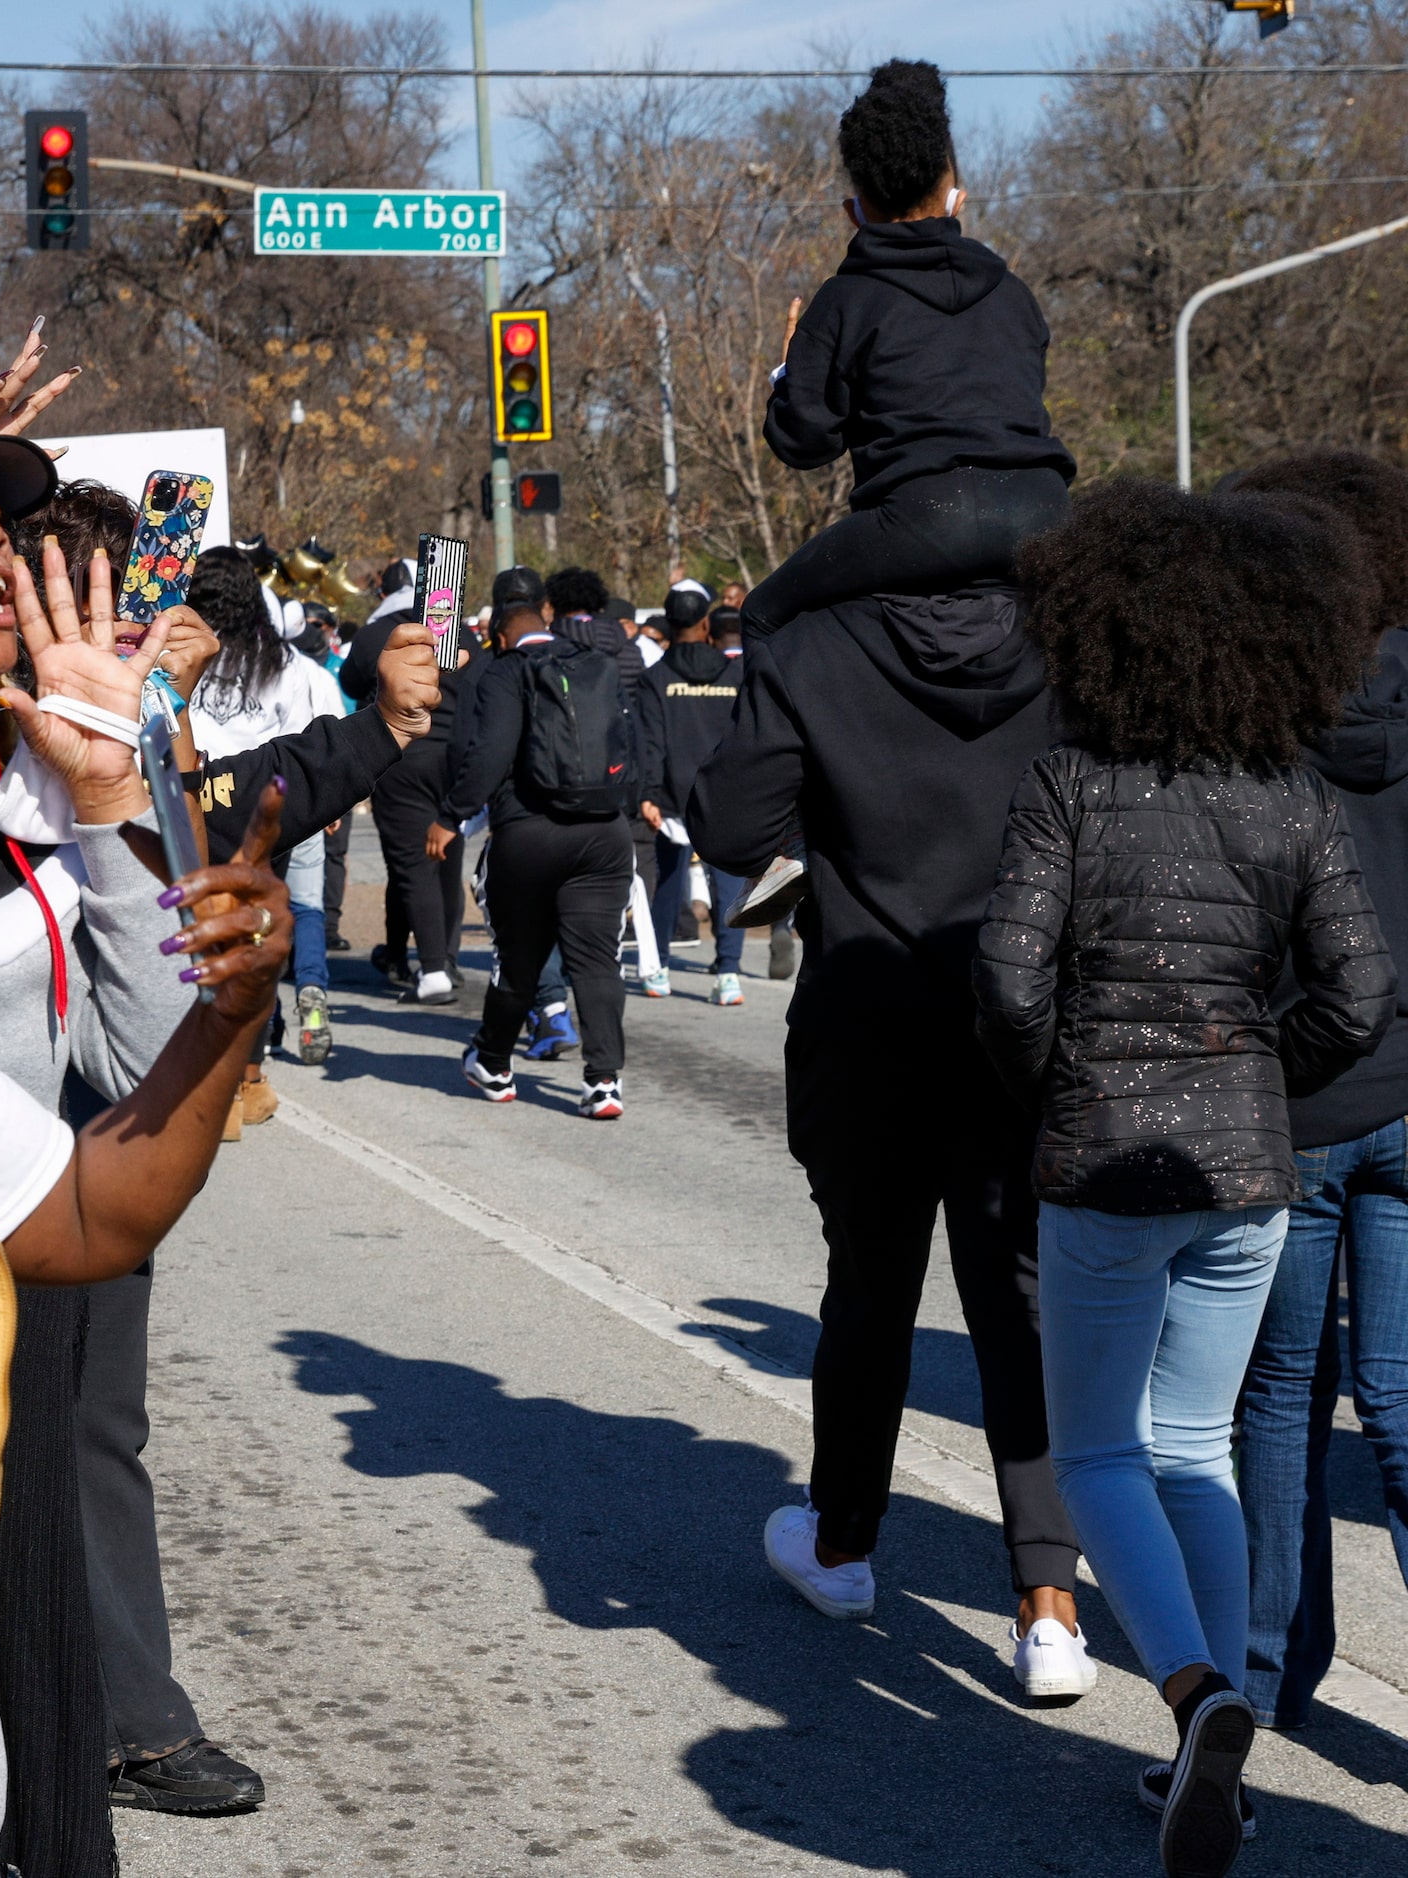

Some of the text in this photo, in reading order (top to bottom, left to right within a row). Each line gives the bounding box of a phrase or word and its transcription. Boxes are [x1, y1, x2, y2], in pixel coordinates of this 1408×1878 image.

[266, 197, 496, 230] Ann Arbor
[262, 231, 322, 249] 600 E
[440, 233, 498, 250] 700 E
